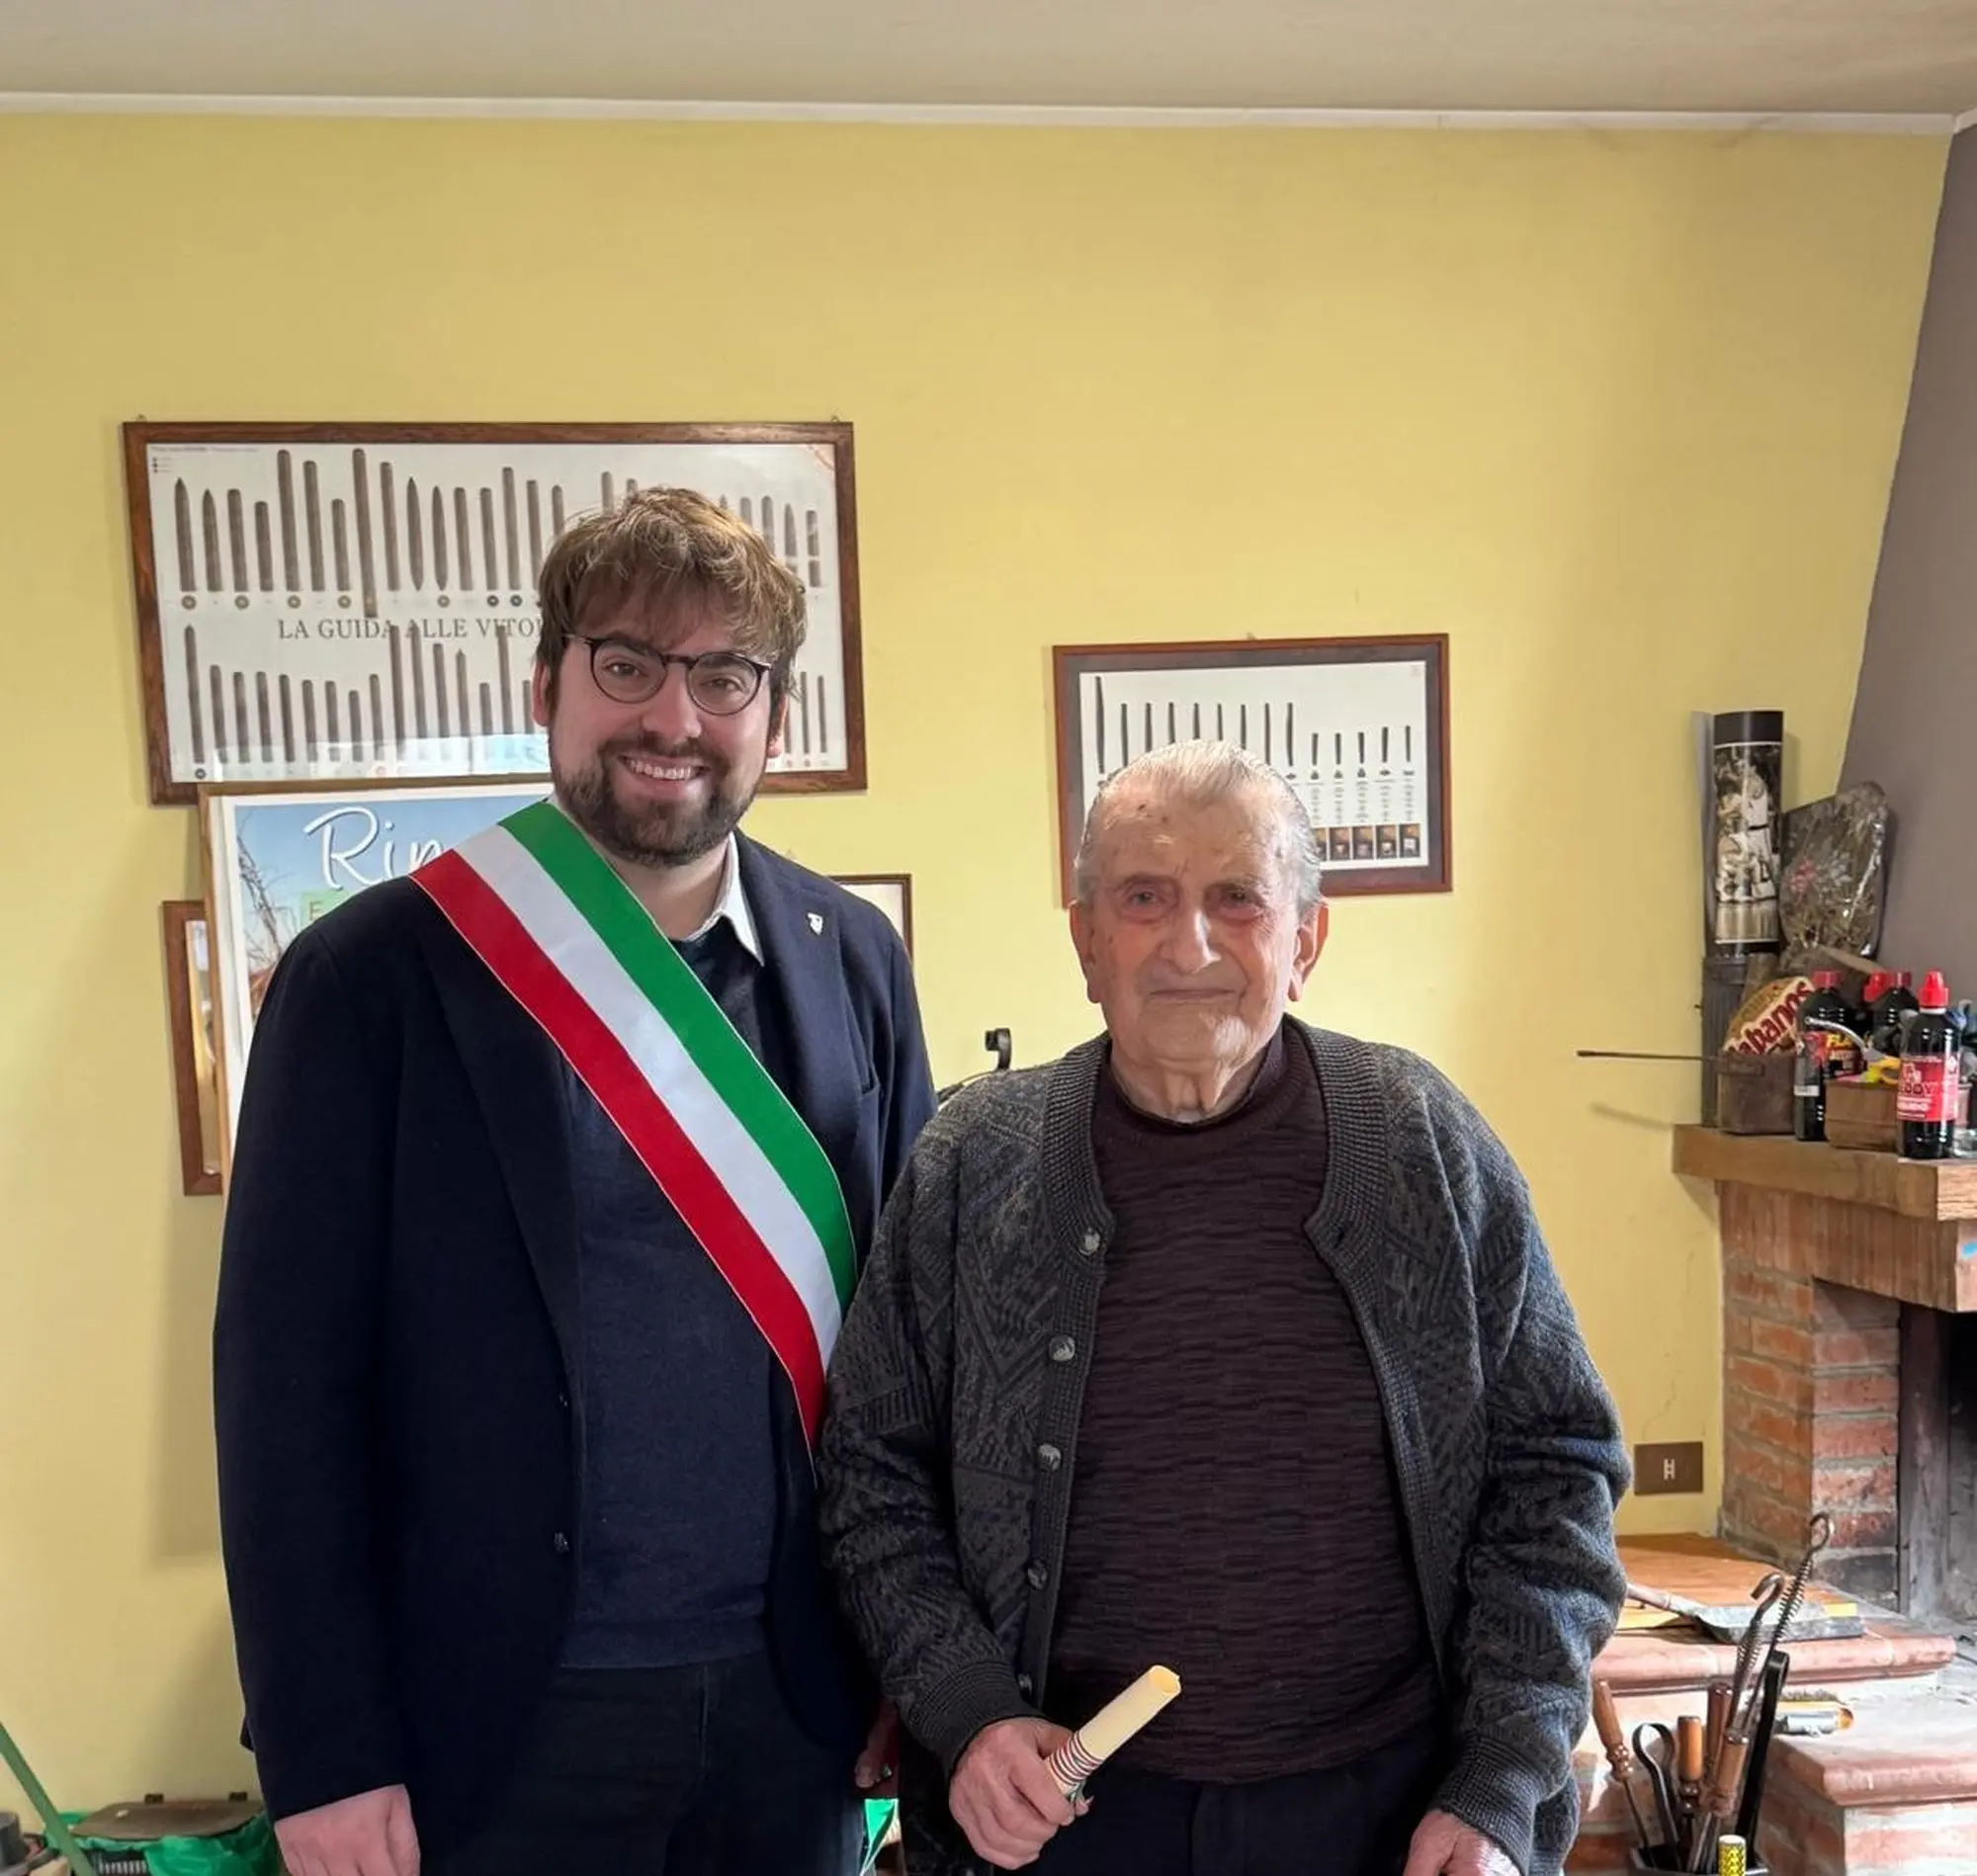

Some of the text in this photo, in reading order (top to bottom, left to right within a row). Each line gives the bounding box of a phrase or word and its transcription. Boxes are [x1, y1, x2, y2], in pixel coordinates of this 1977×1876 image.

[279, 619, 309, 640] LA
[317, 618, 396, 640] GUIDA
[404, 617, 469, 639] ALLE
[302, 806, 444, 890] Rin
[1727, 981, 1813, 1056] abanos
